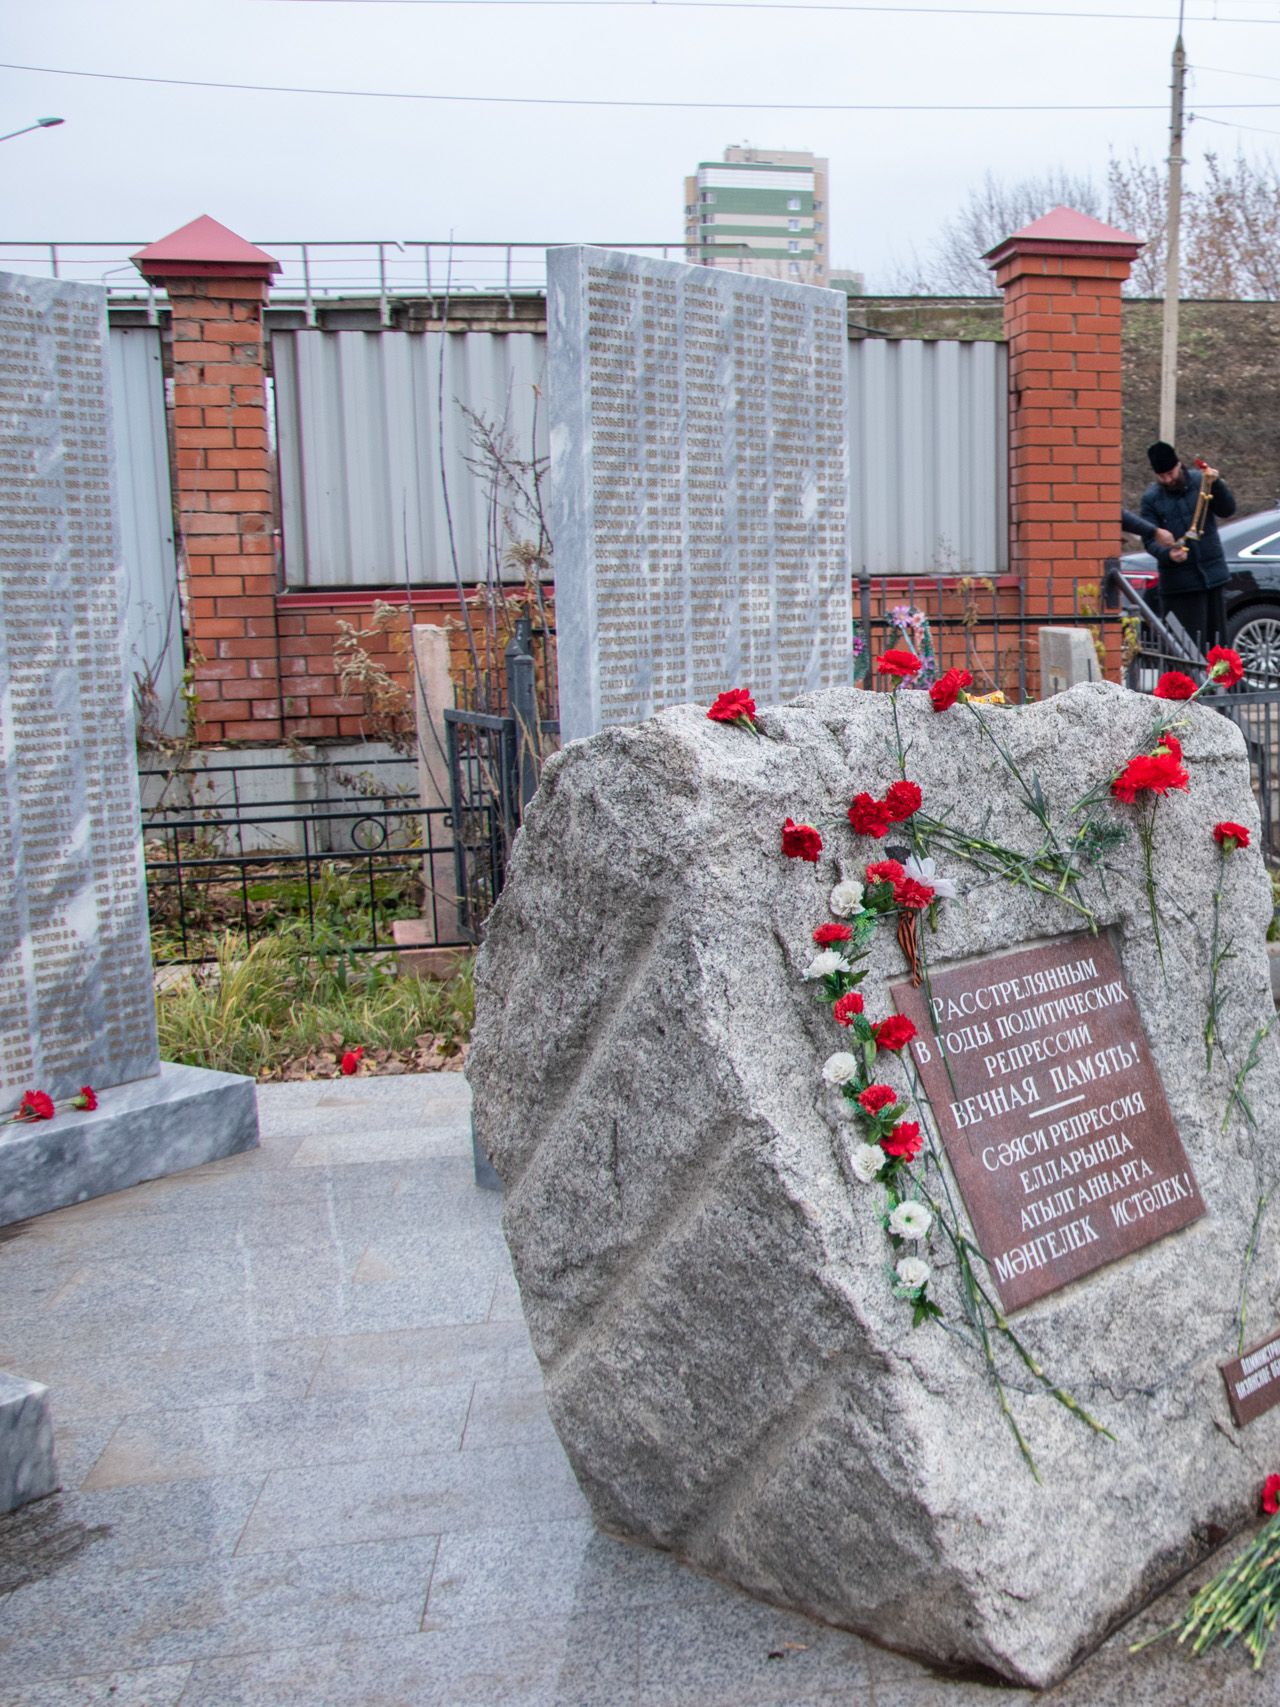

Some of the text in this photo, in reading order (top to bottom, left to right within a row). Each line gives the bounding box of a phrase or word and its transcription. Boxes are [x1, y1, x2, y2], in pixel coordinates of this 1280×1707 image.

[916, 1040, 931, 1064] В
[997, 981, 1129, 1041] ПОЛИТИЧЕСКИХ
[930, 958, 1098, 1023] РАССТРЕЛЯННЫМ
[984, 1023, 1093, 1078] РЕПРЕССИЙ
[949, 1041, 1142, 1130] ВЕЧНАЯ ПАМЯТЬ!
[982, 1091, 1147, 1172] СӘЯСИ РЕПРЕССИЯ
[1019, 1133, 1134, 1194] ЕЛЛАРЫНДА
[1020, 1159, 1154, 1232] АТЫЛГАННАРГА
[1109, 1171, 1195, 1229] ИСТӘЛЕК!
